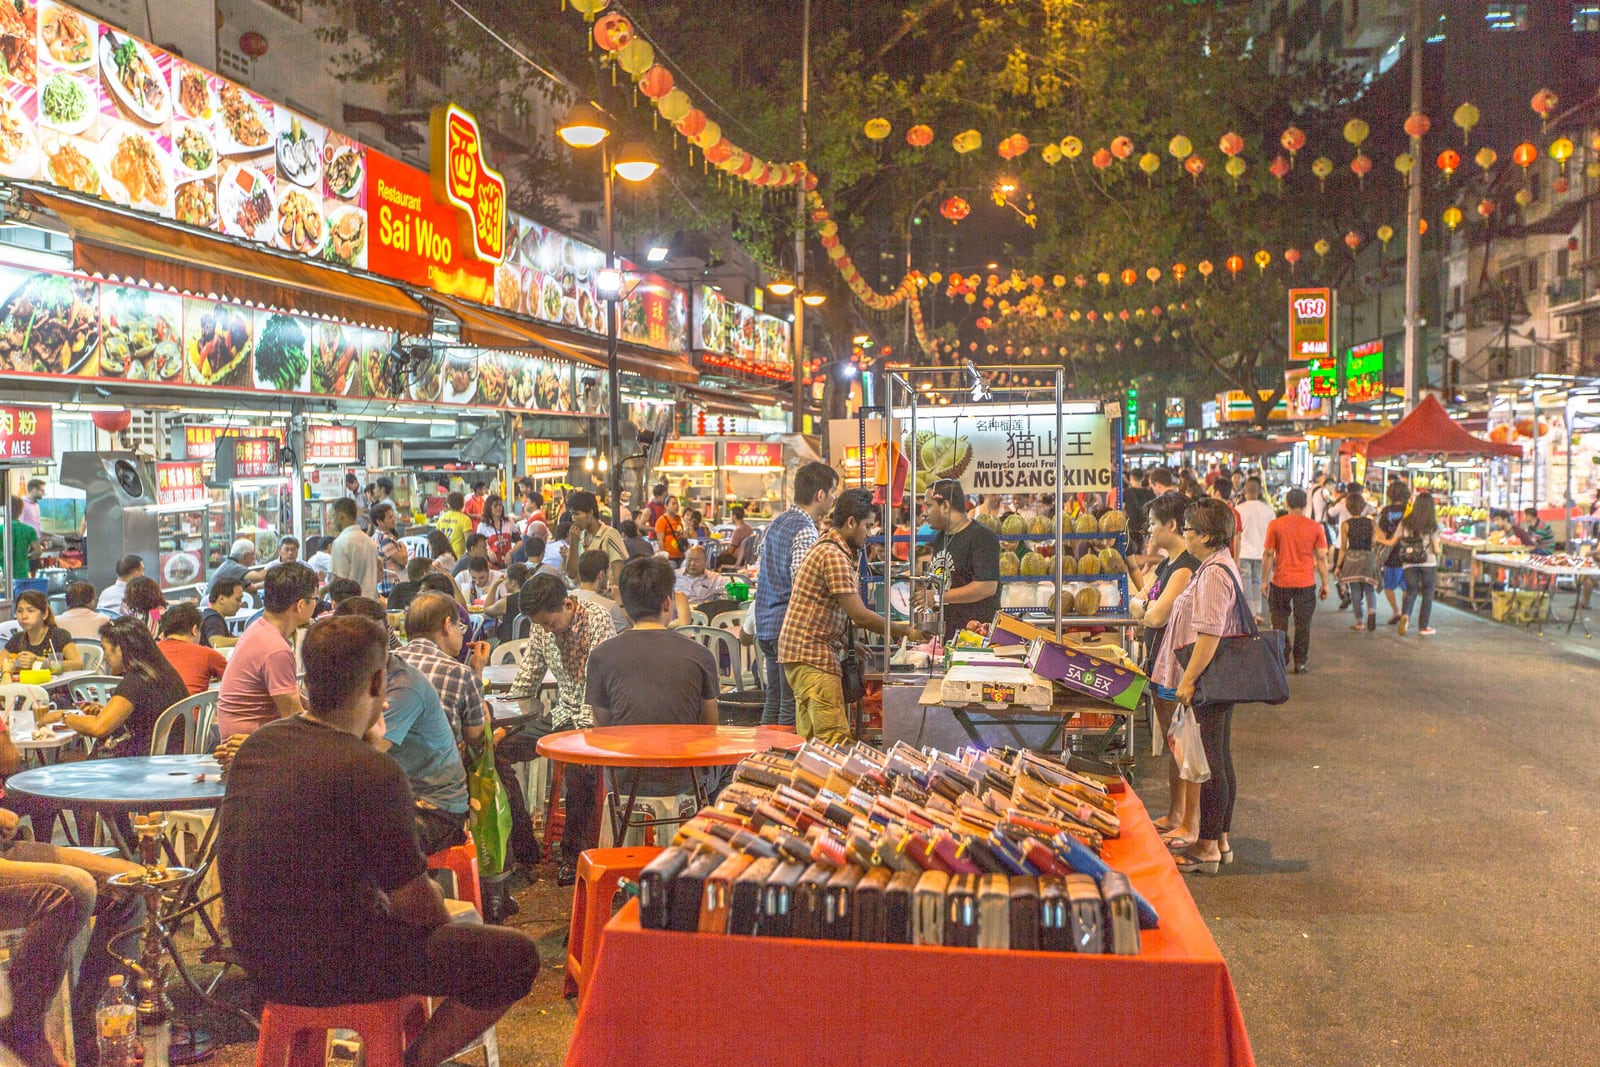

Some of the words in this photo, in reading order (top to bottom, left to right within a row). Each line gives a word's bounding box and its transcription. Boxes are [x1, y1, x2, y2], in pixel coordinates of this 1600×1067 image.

[378, 178, 421, 212] Restaurant
[380, 205, 410, 252] Sai
[415, 216, 452, 264] Woo
[1294, 298, 1327, 318] 168
[11, 440, 31, 455] MEE
[1006, 430, 1094, 459] 猫山王
[735, 455, 772, 466] SATAY
[977, 460, 1015, 471] Malaysia
[973, 470, 1056, 488] MUSANG
[1063, 468, 1111, 486] KING
[1066, 667, 1111, 692] SAPEX
